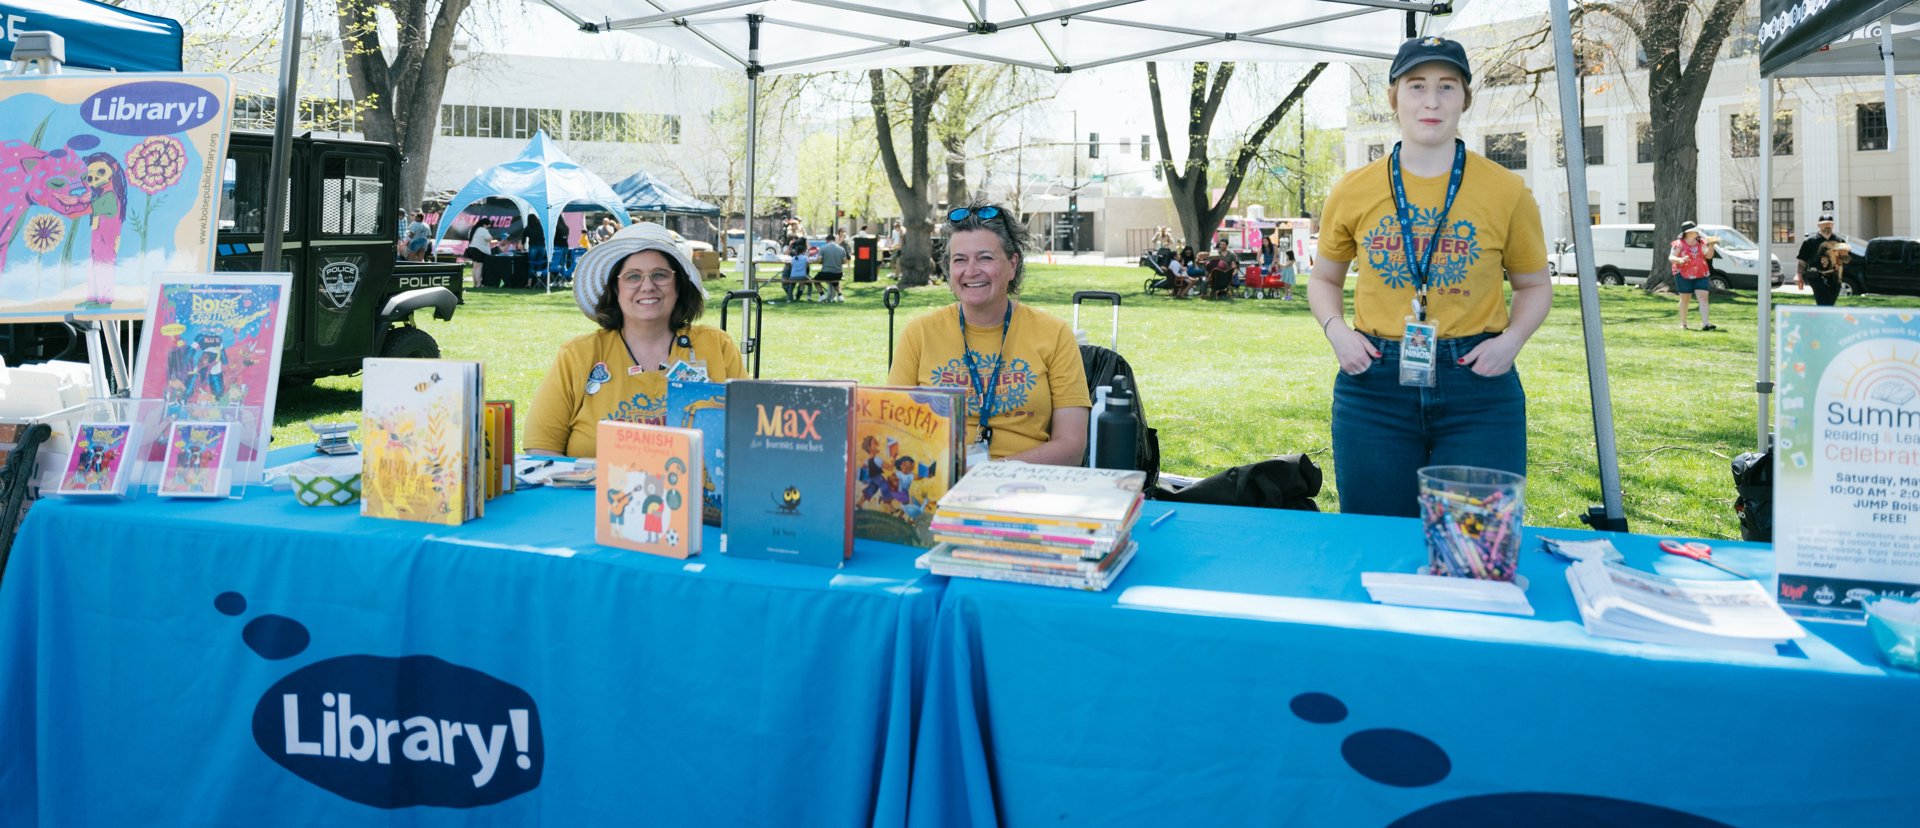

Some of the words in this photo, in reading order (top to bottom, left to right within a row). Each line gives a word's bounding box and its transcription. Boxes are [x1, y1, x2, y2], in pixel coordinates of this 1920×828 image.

[91, 96, 208, 126] Library!
[200, 133, 219, 245] www.boisepubliclibrary.org
[326, 266, 355, 275] POLICE
[400, 276, 450, 288] POLICE
[755, 404, 821, 440] Max
[1828, 402, 1920, 428] Summ
[617, 429, 673, 448] SPANISH
[1824, 430, 1879, 445] Reading
[1897, 433, 1920, 445] Lea
[1825, 443, 1920, 466] Celebrat
[1836, 473, 1896, 487] Saturday,
[1830, 485, 1864, 496] 10:00
[1868, 487, 1886, 497] AM
[1900, 489, 1920, 499] 2:0
[1853, 500, 1888, 510] JUMP
[1892, 501, 1920, 512] Bois
[1873, 513, 1907, 524] FREE!
[283, 692, 531, 788] Library!
